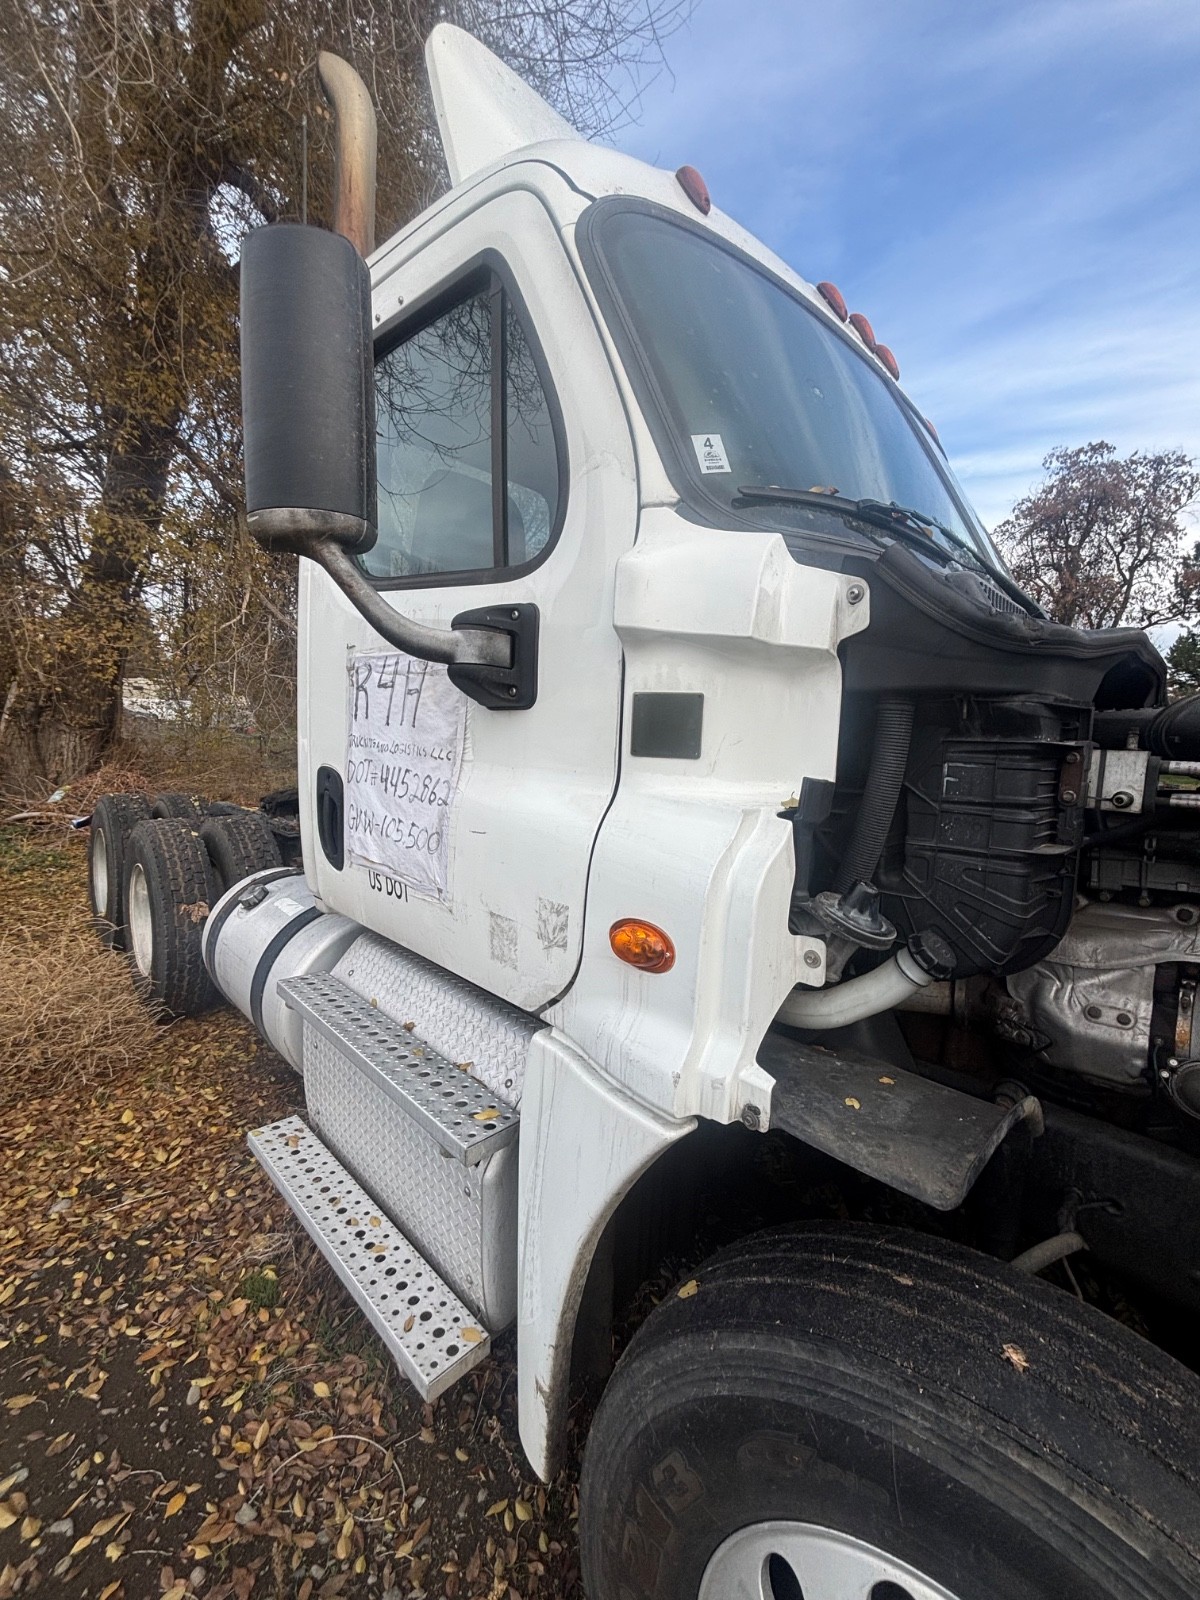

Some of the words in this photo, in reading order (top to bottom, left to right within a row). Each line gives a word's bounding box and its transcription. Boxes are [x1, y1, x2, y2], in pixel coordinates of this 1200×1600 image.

[703, 437, 714, 449] 4
[353, 656, 429, 728] R4H
[430, 747, 453, 761] LLC
[368, 869, 383, 892] US
